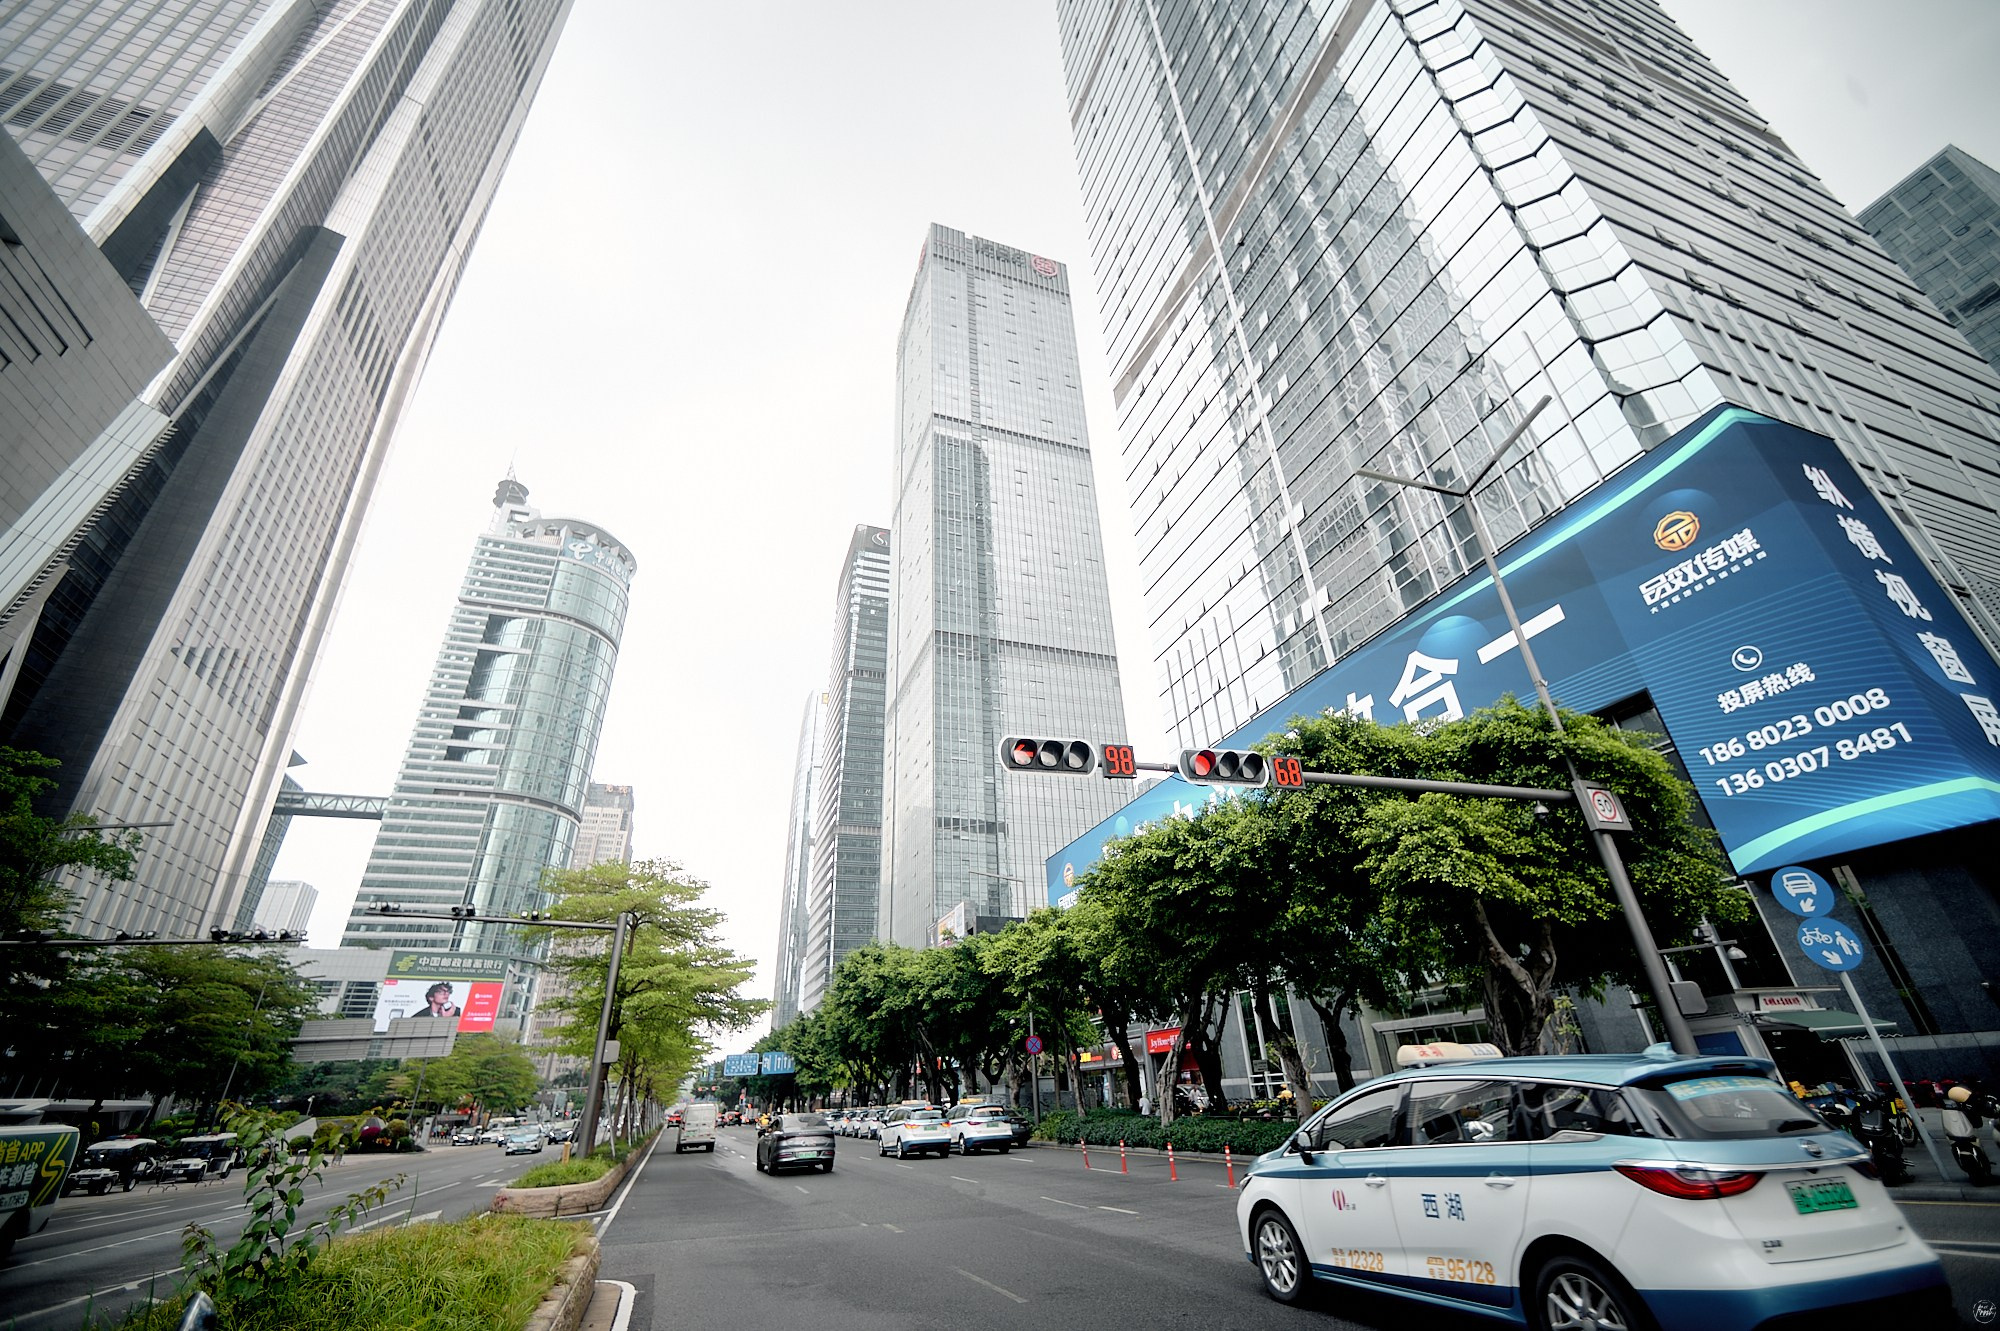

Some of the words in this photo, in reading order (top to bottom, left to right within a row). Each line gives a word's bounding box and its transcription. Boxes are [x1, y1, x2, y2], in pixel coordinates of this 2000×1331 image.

[1716, 662, 1816, 714] 投屏热线
[1698, 737, 1746, 766] 186
[1745, 714, 1813, 751] 8023
[1814, 687, 1891, 727] 0008
[1105, 745, 1135, 775] 98
[1274, 757, 1302, 787] 68
[1716, 768, 1765, 797] 136
[1765, 745, 1830, 783] 0307
[1835, 721, 1913, 761] 8481
[1420, 1192, 1466, 1222] 西湖
[1348, 1249, 1385, 1272] 12328
[1447, 1257, 1496, 1284] 95128
